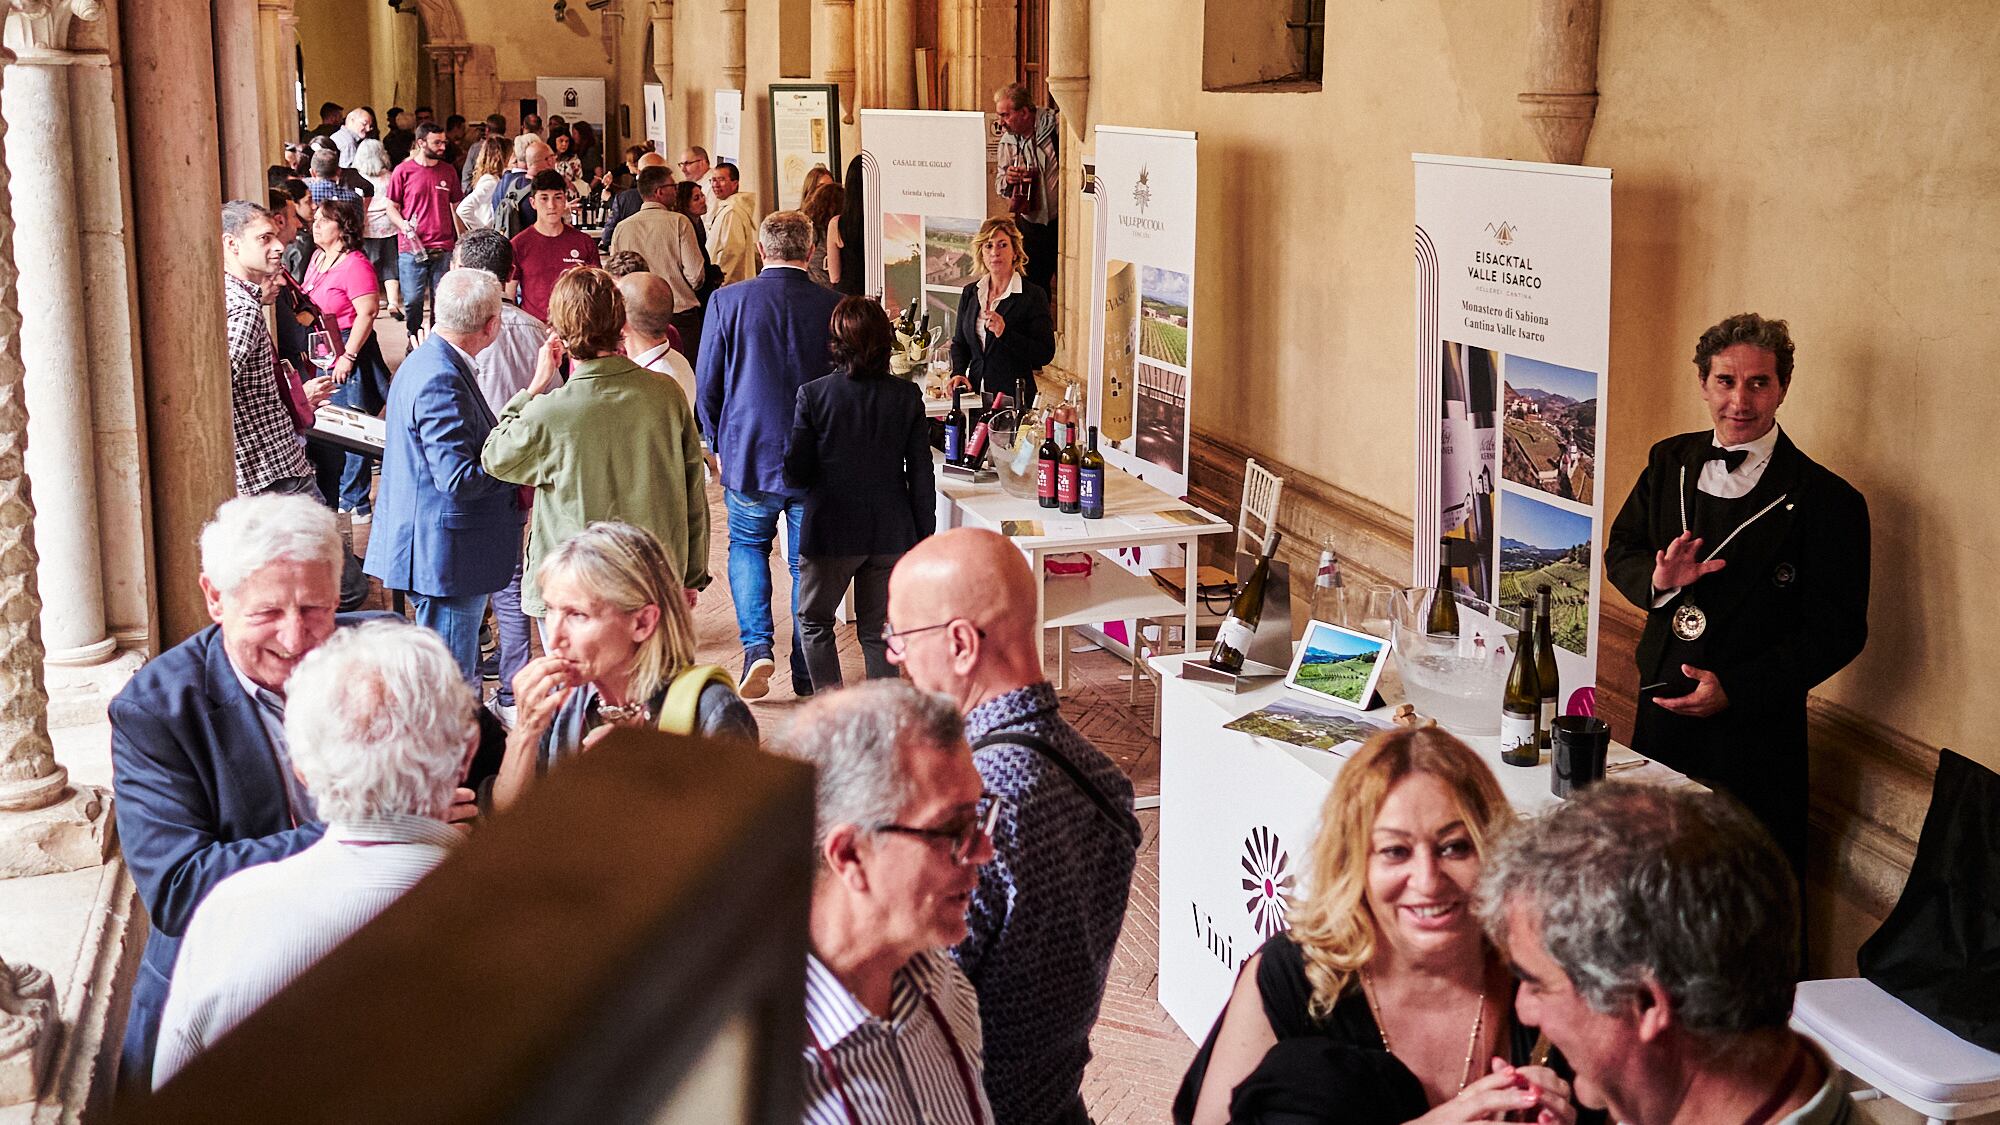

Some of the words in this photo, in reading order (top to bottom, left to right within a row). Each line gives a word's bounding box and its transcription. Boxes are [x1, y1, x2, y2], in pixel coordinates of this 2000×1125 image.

[892, 159, 917, 168] CASALE
[918, 160, 929, 168] DEL
[902, 189, 922, 197] Azienda
[923, 190, 945, 199] Agricola
[1475, 251, 1533, 271] EISACKTAL
[1467, 266, 1497, 282] VALLE
[1502, 272, 1542, 289] ISARCO
[1461, 299, 1503, 317] Monastero
[1505, 307, 1513, 319] di
[1515, 310, 1549, 326] Sabiona
[1464, 316, 1495, 333] Cantina
[1497, 323, 1516, 337] Valle
[1518, 327, 1545, 343] Isarco
[1191, 900, 1233, 972] Vini
